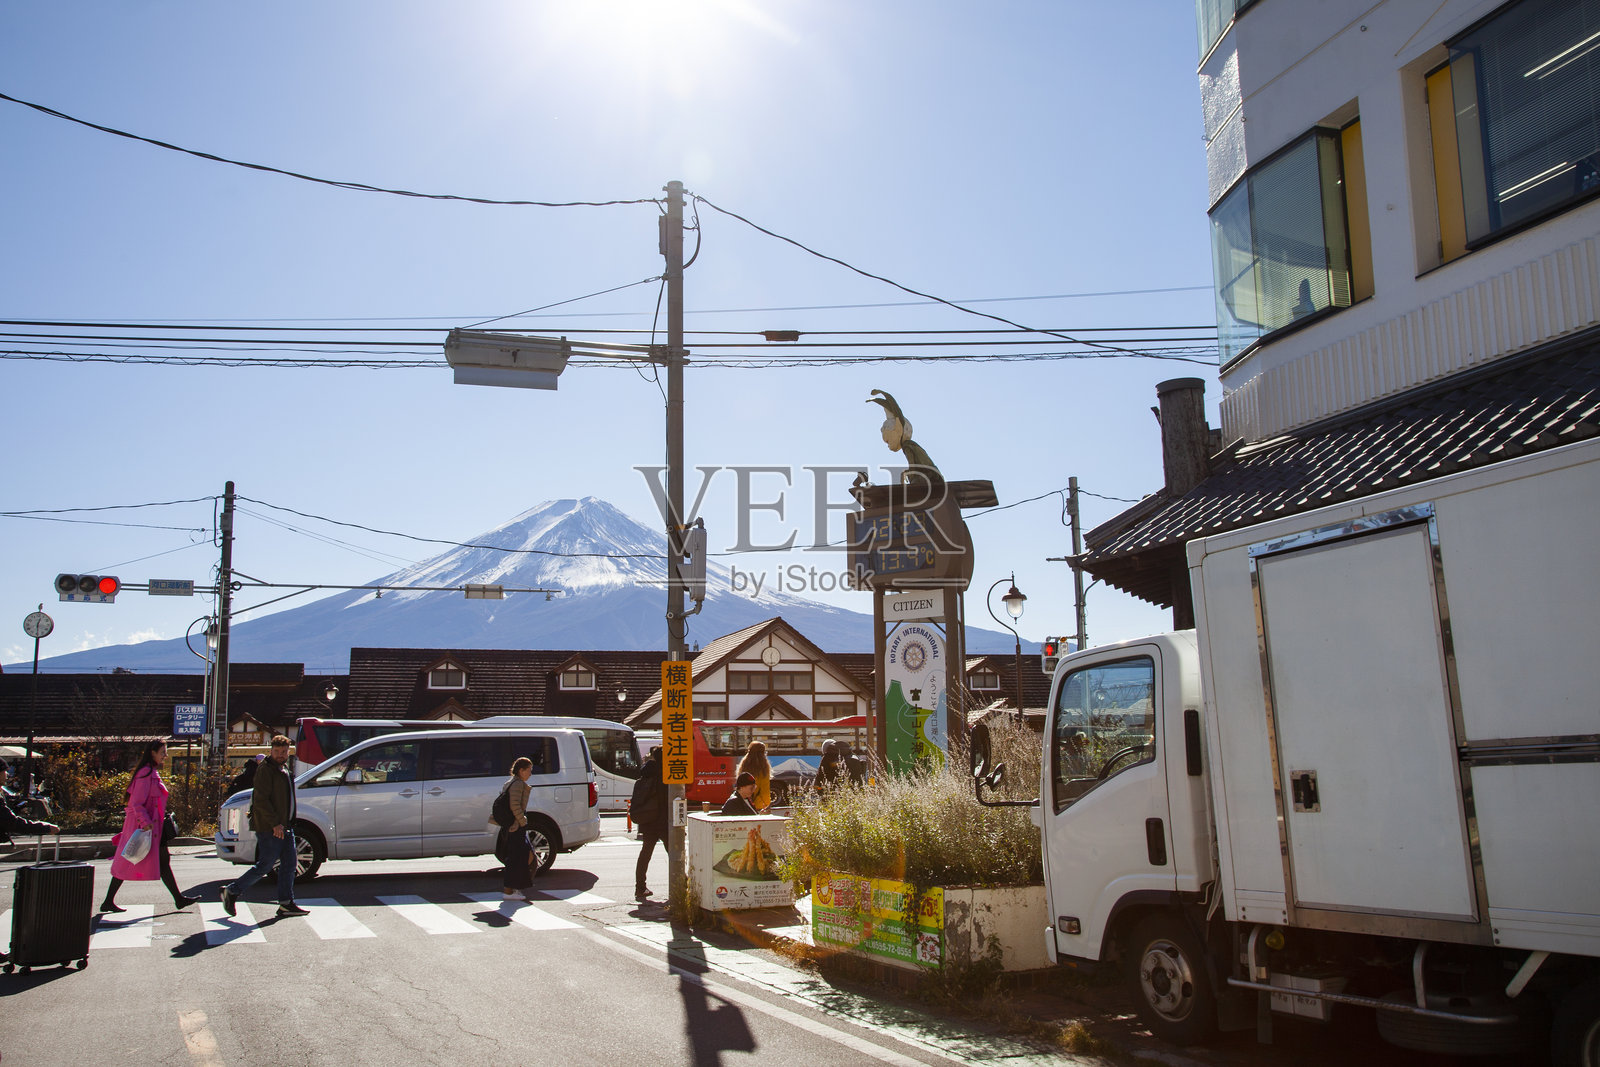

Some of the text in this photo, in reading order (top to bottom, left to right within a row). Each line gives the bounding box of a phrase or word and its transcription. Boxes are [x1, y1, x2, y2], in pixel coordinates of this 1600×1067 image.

[893, 599, 933, 612] CITIZEN
[890, 635, 902, 664] ROTARY
[902, 626, 939, 660] INTERNATIONAL
[666, 664, 689, 781] 横断者注意
